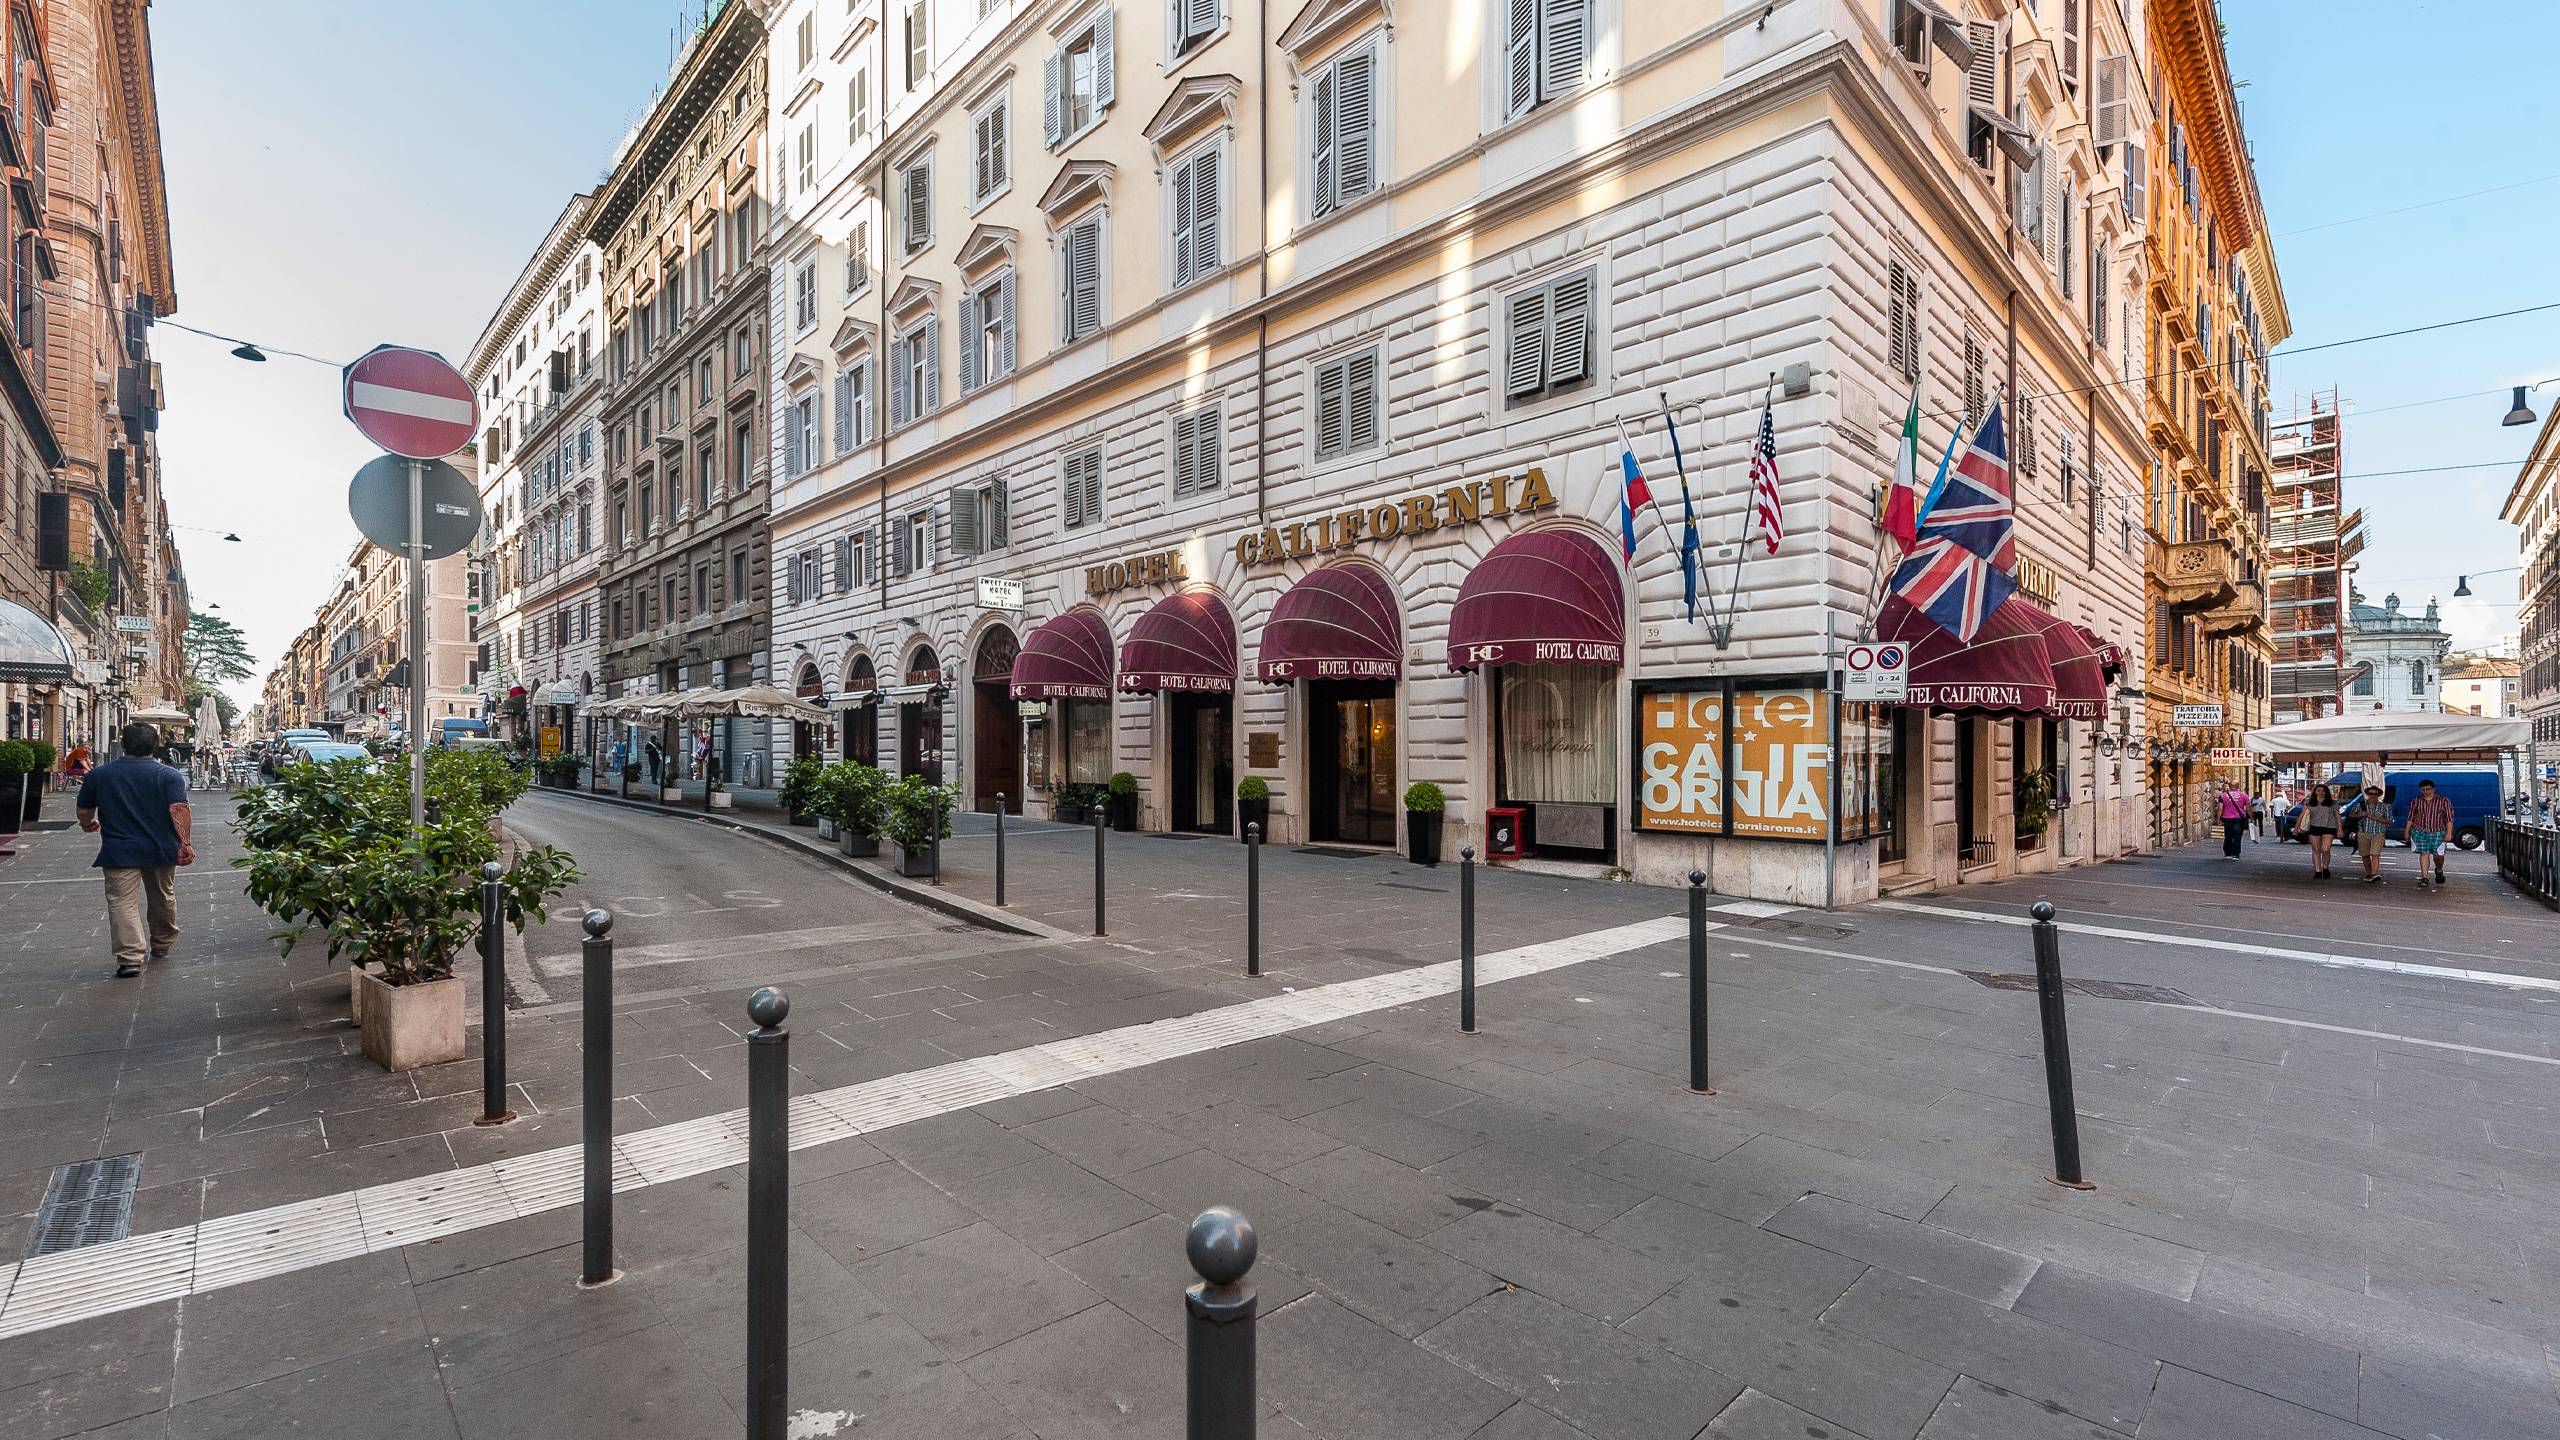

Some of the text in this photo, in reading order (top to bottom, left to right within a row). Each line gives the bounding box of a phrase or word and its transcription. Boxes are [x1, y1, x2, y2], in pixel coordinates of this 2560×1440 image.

[1085, 466, 1557, 594] HOTEL CALIFORNIA
[989, 587, 1011, 595] HOTEL
[1648, 628, 1659, 638] 39
[1536, 643, 1573, 660] HOTEL
[1577, 643, 1620, 661] CALIFORNIA
[1318, 661, 1350, 675] HOTEL
[1353, 661, 1396, 676] CALIFORNIA
[1160, 675, 1187, 688] HOTEL
[1190, 677, 1231, 690] CALIFORNIA
[1043, 685, 1067, 696] HOTEL
[1069, 685, 1107, 698] CALIFORNIA
[1940, 686, 2022, 705] CALIFORNIA
[744, 703, 827, 721] RISTORANTE PIZZERIA
[2175, 705, 2220, 713] TRATTORIA
[1642, 742, 1828, 782] CALIF
[2213, 749, 2252, 759] HOTEL
[1642, 776, 1828, 821] ORNIA
[1649, 817, 1818, 835] www.hotelcaforniaroma.it
